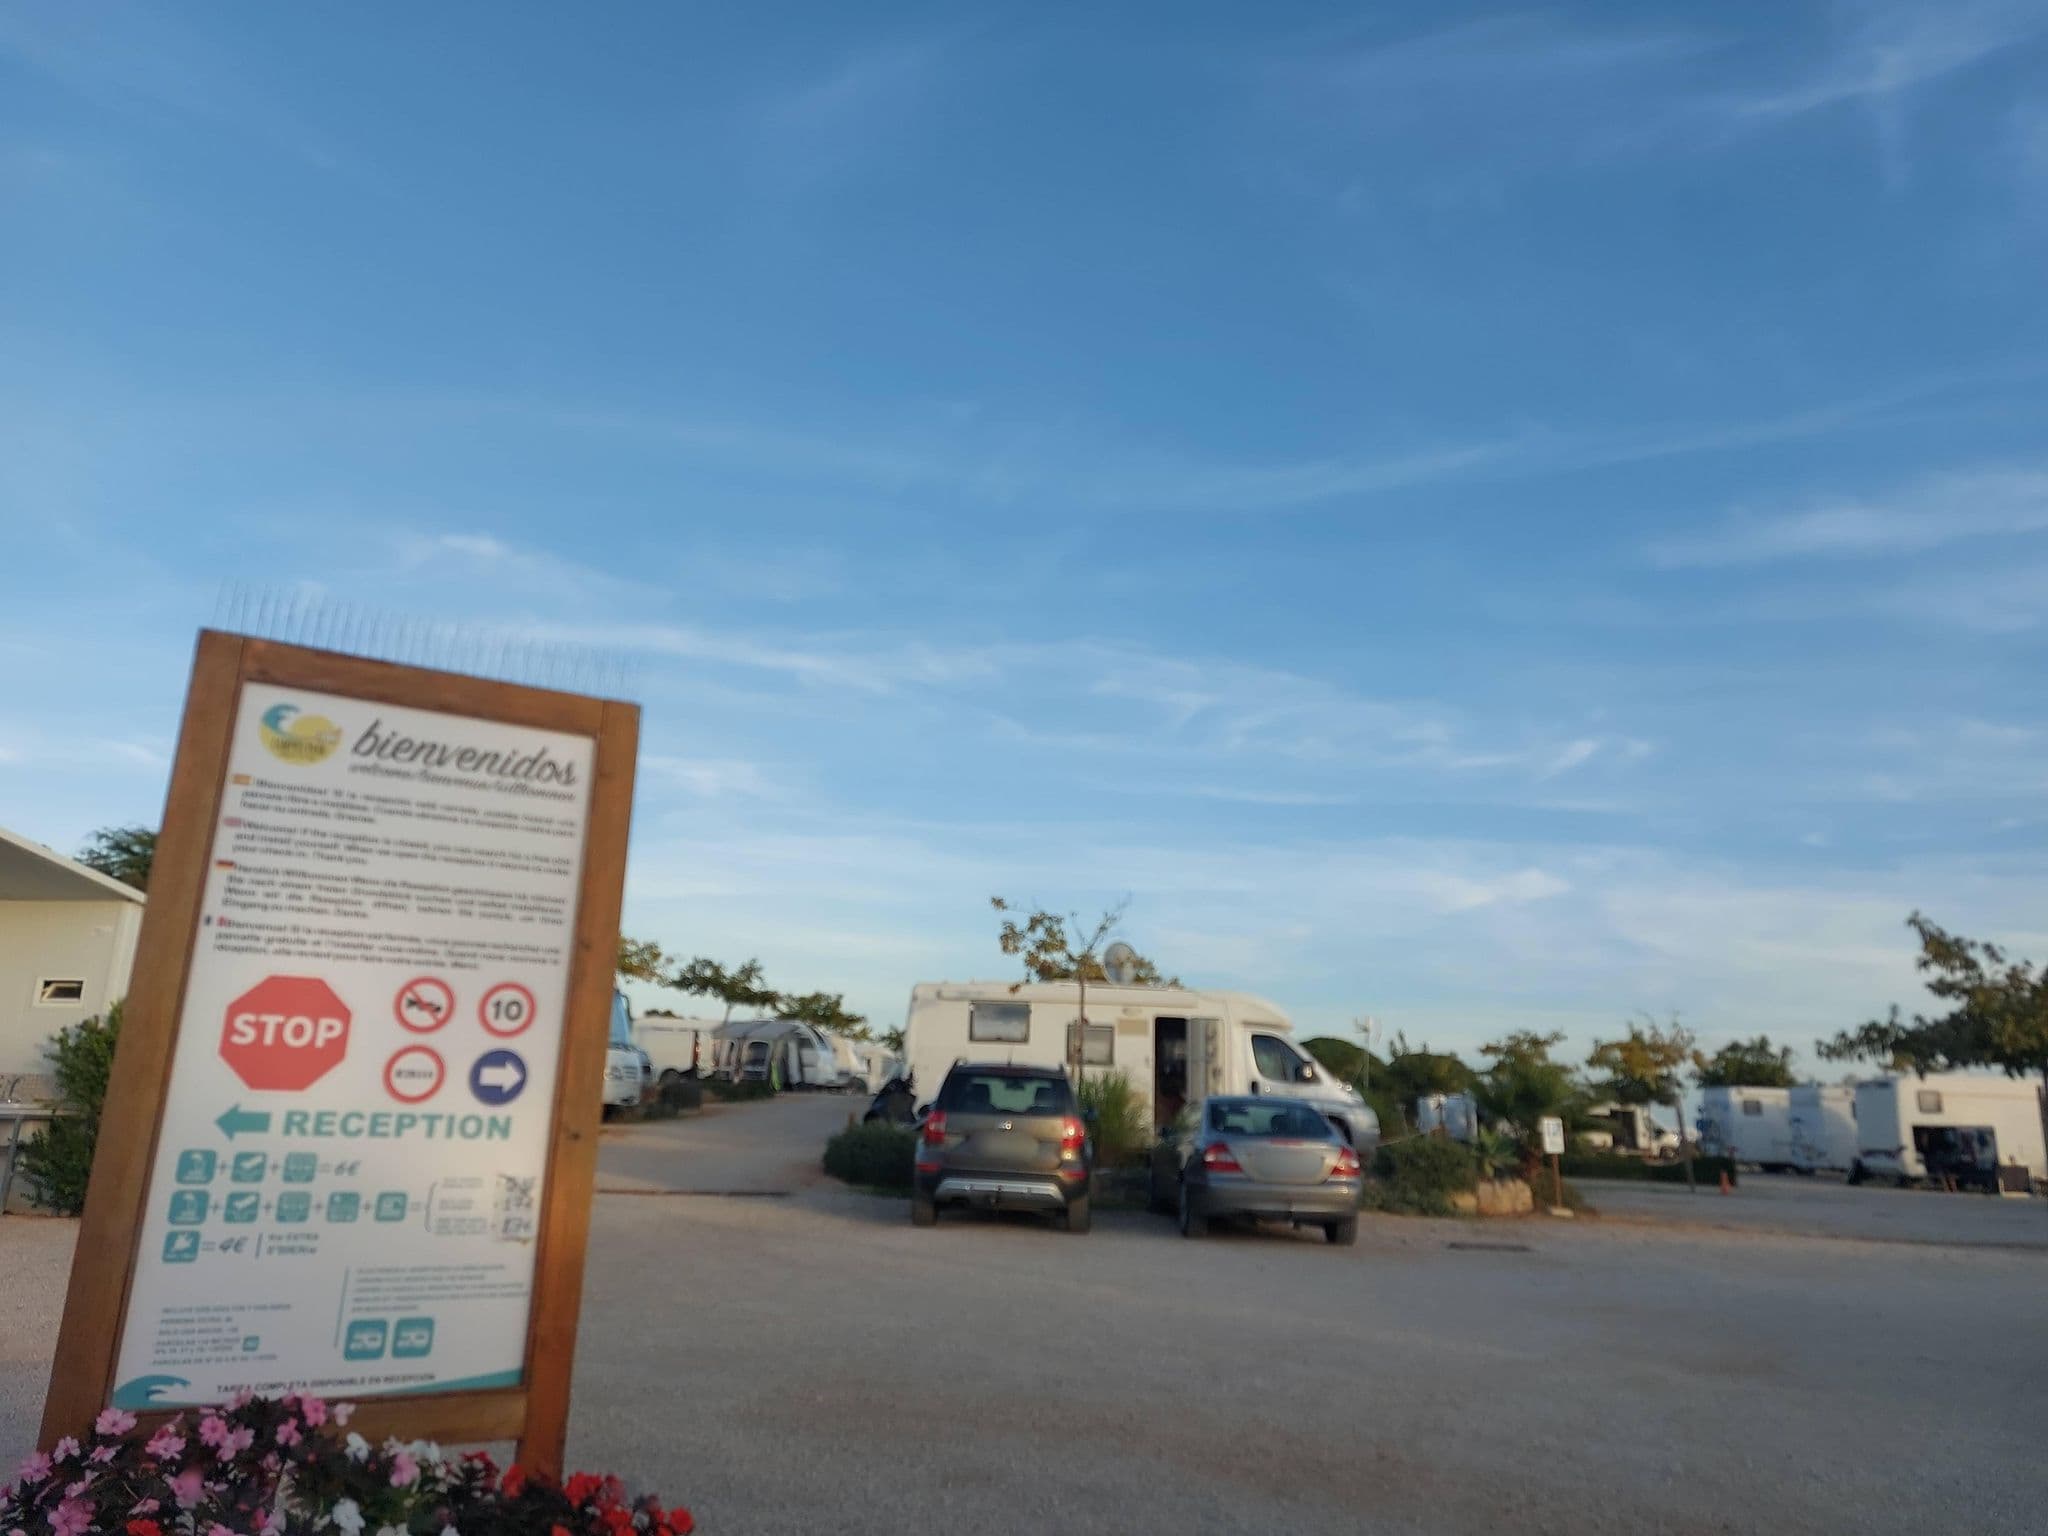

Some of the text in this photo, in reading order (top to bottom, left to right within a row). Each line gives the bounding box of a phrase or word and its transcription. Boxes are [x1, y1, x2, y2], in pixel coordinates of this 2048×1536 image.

[351, 717, 577, 787] bienvenidos
[491, 999, 524, 1022] 10
[229, 1013, 345, 1049] STOP
[282, 1110, 513, 1141] RECEPTION
